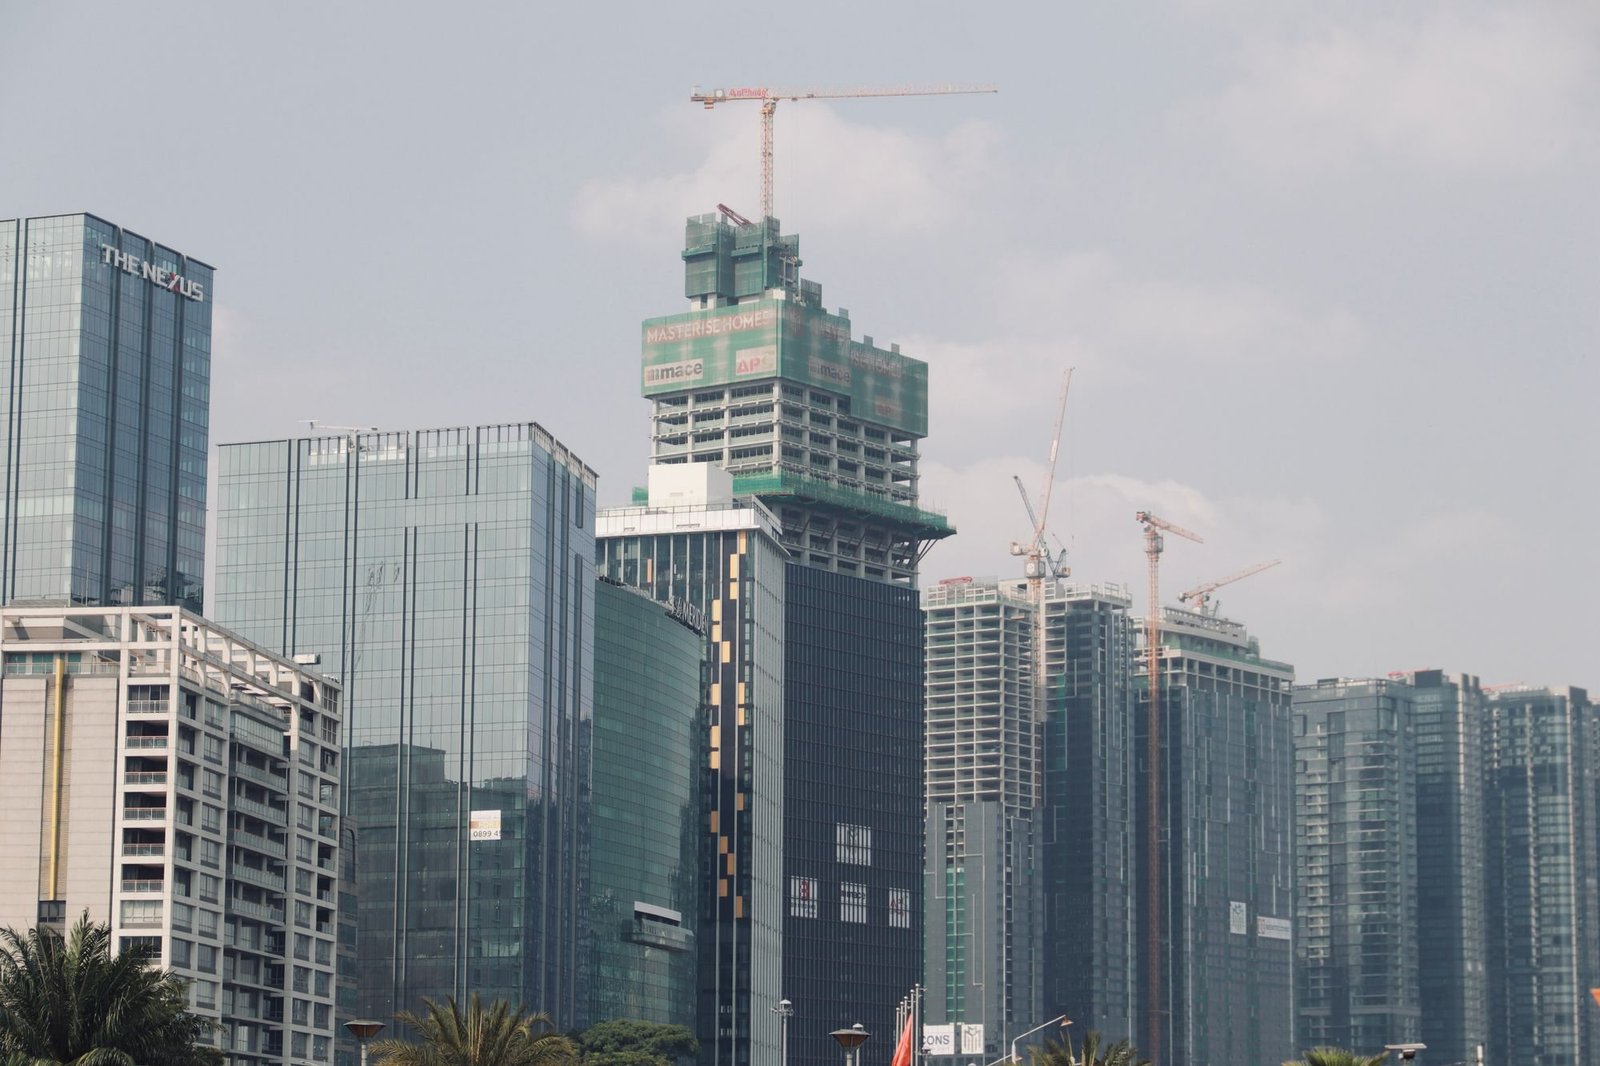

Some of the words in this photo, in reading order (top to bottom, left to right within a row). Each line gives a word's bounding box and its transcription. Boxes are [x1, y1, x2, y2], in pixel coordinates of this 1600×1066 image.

[101, 243, 140, 276] THE
[142, 260, 204, 302] NEXUS
[646, 318, 721, 344] MASTERISE
[723, 309, 770, 332] HOMES
